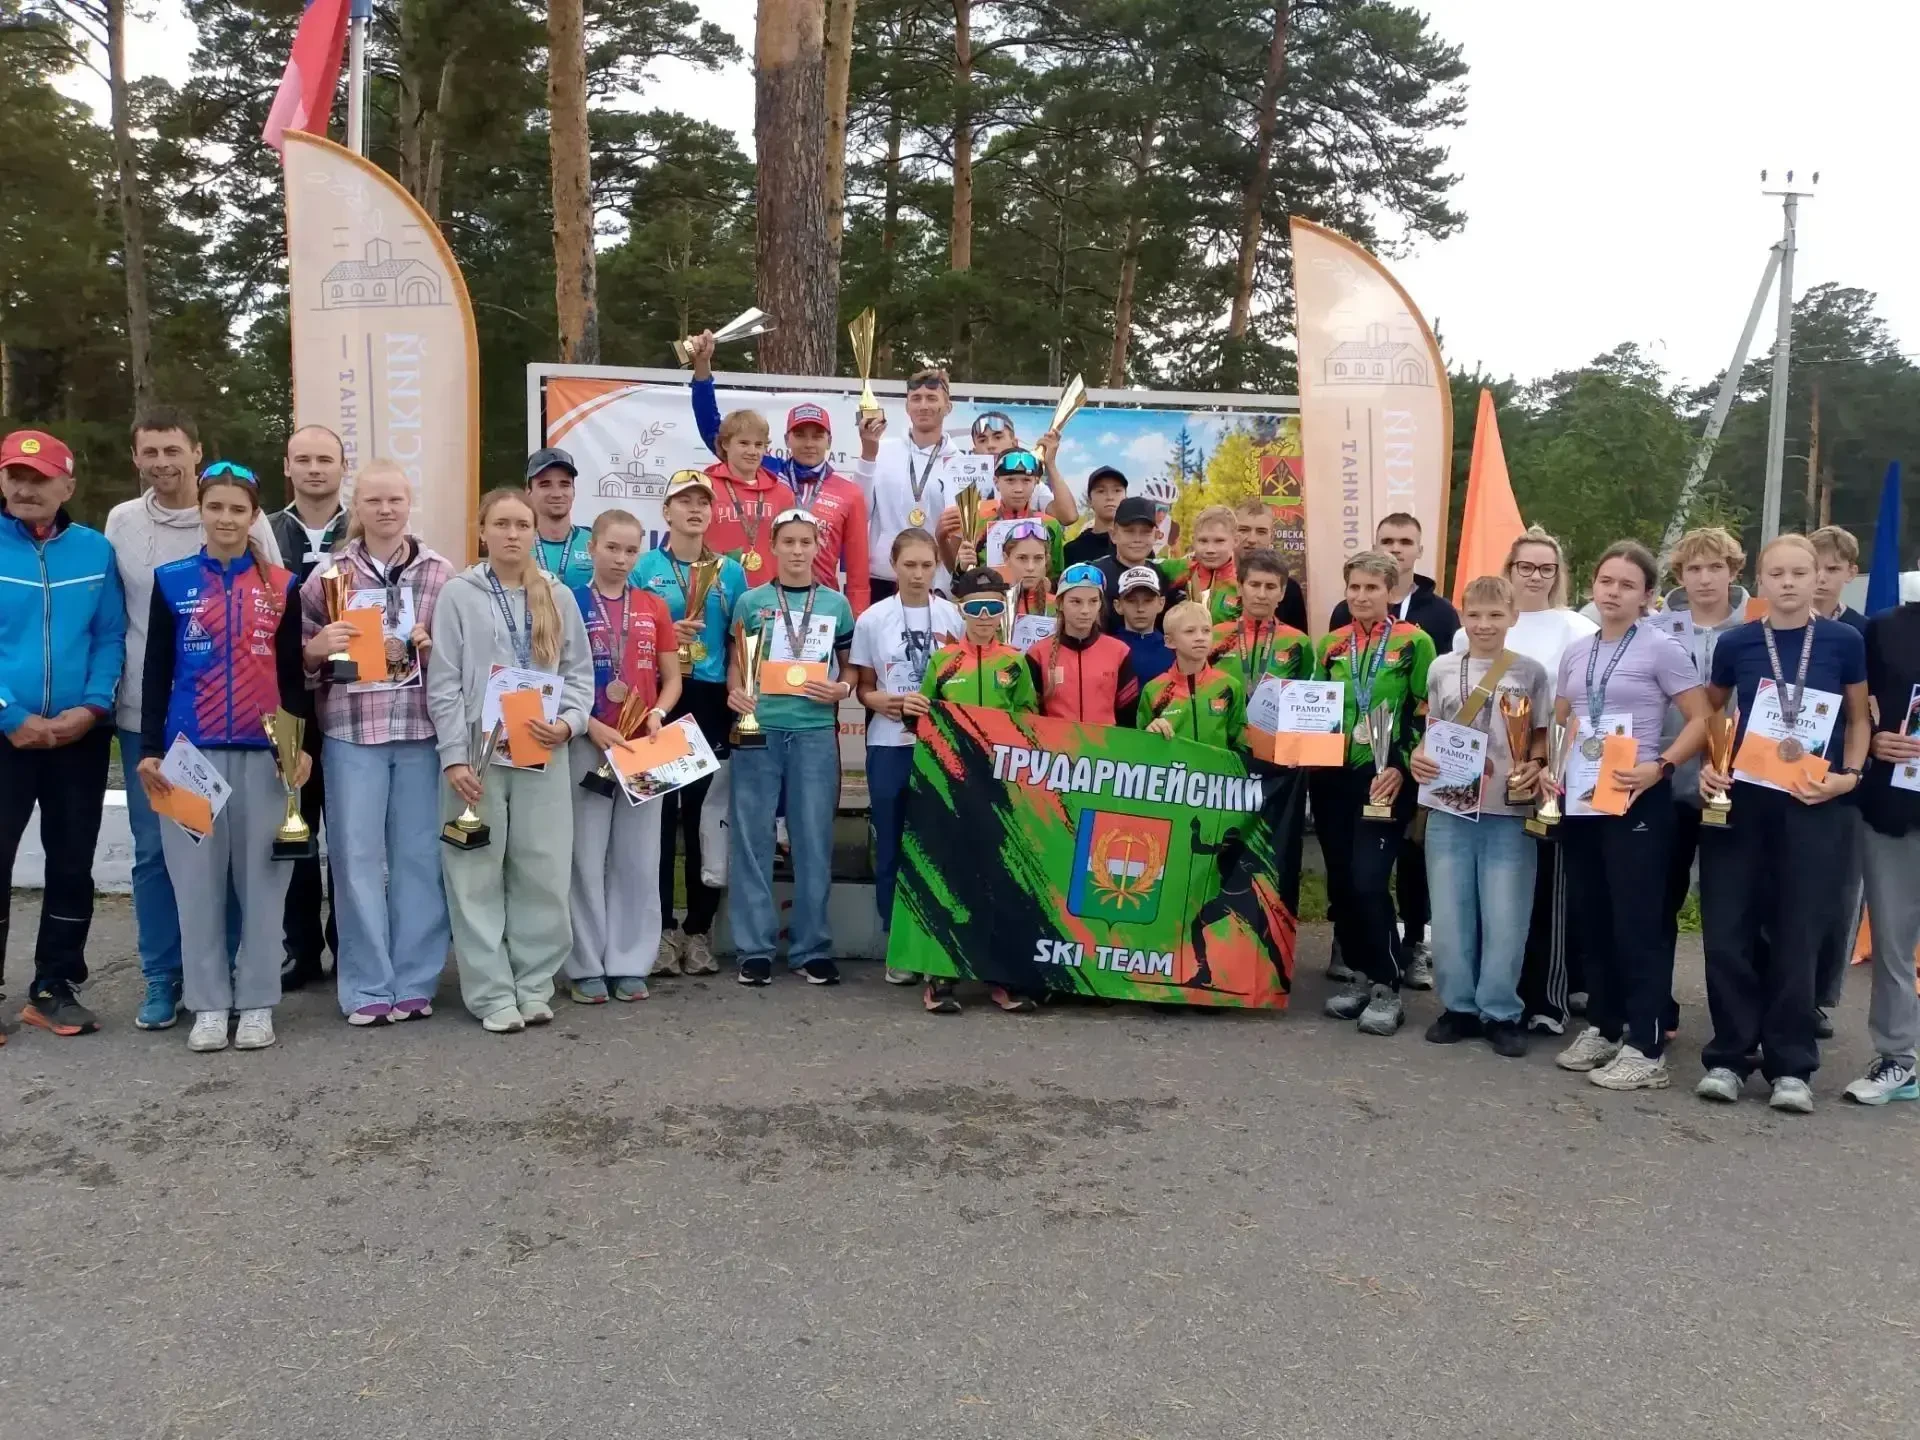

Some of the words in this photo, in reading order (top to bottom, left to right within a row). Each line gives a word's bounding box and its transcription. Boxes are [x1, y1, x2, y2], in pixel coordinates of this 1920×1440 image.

[1283, 542, 1305, 551] КУЗБ
[897, 685, 920, 693] ГРАМ
[1290, 704, 1331, 714] ГРАМОТА
[1766, 711, 1817, 730] ГРОТА
[1435, 745, 1474, 763] ГРАМОТА
[991, 744, 1265, 812] ТРУДАРМЕЙСКИЙ
[1033, 939, 1085, 967] SKI
[1095, 944, 1175, 976] TEAM
